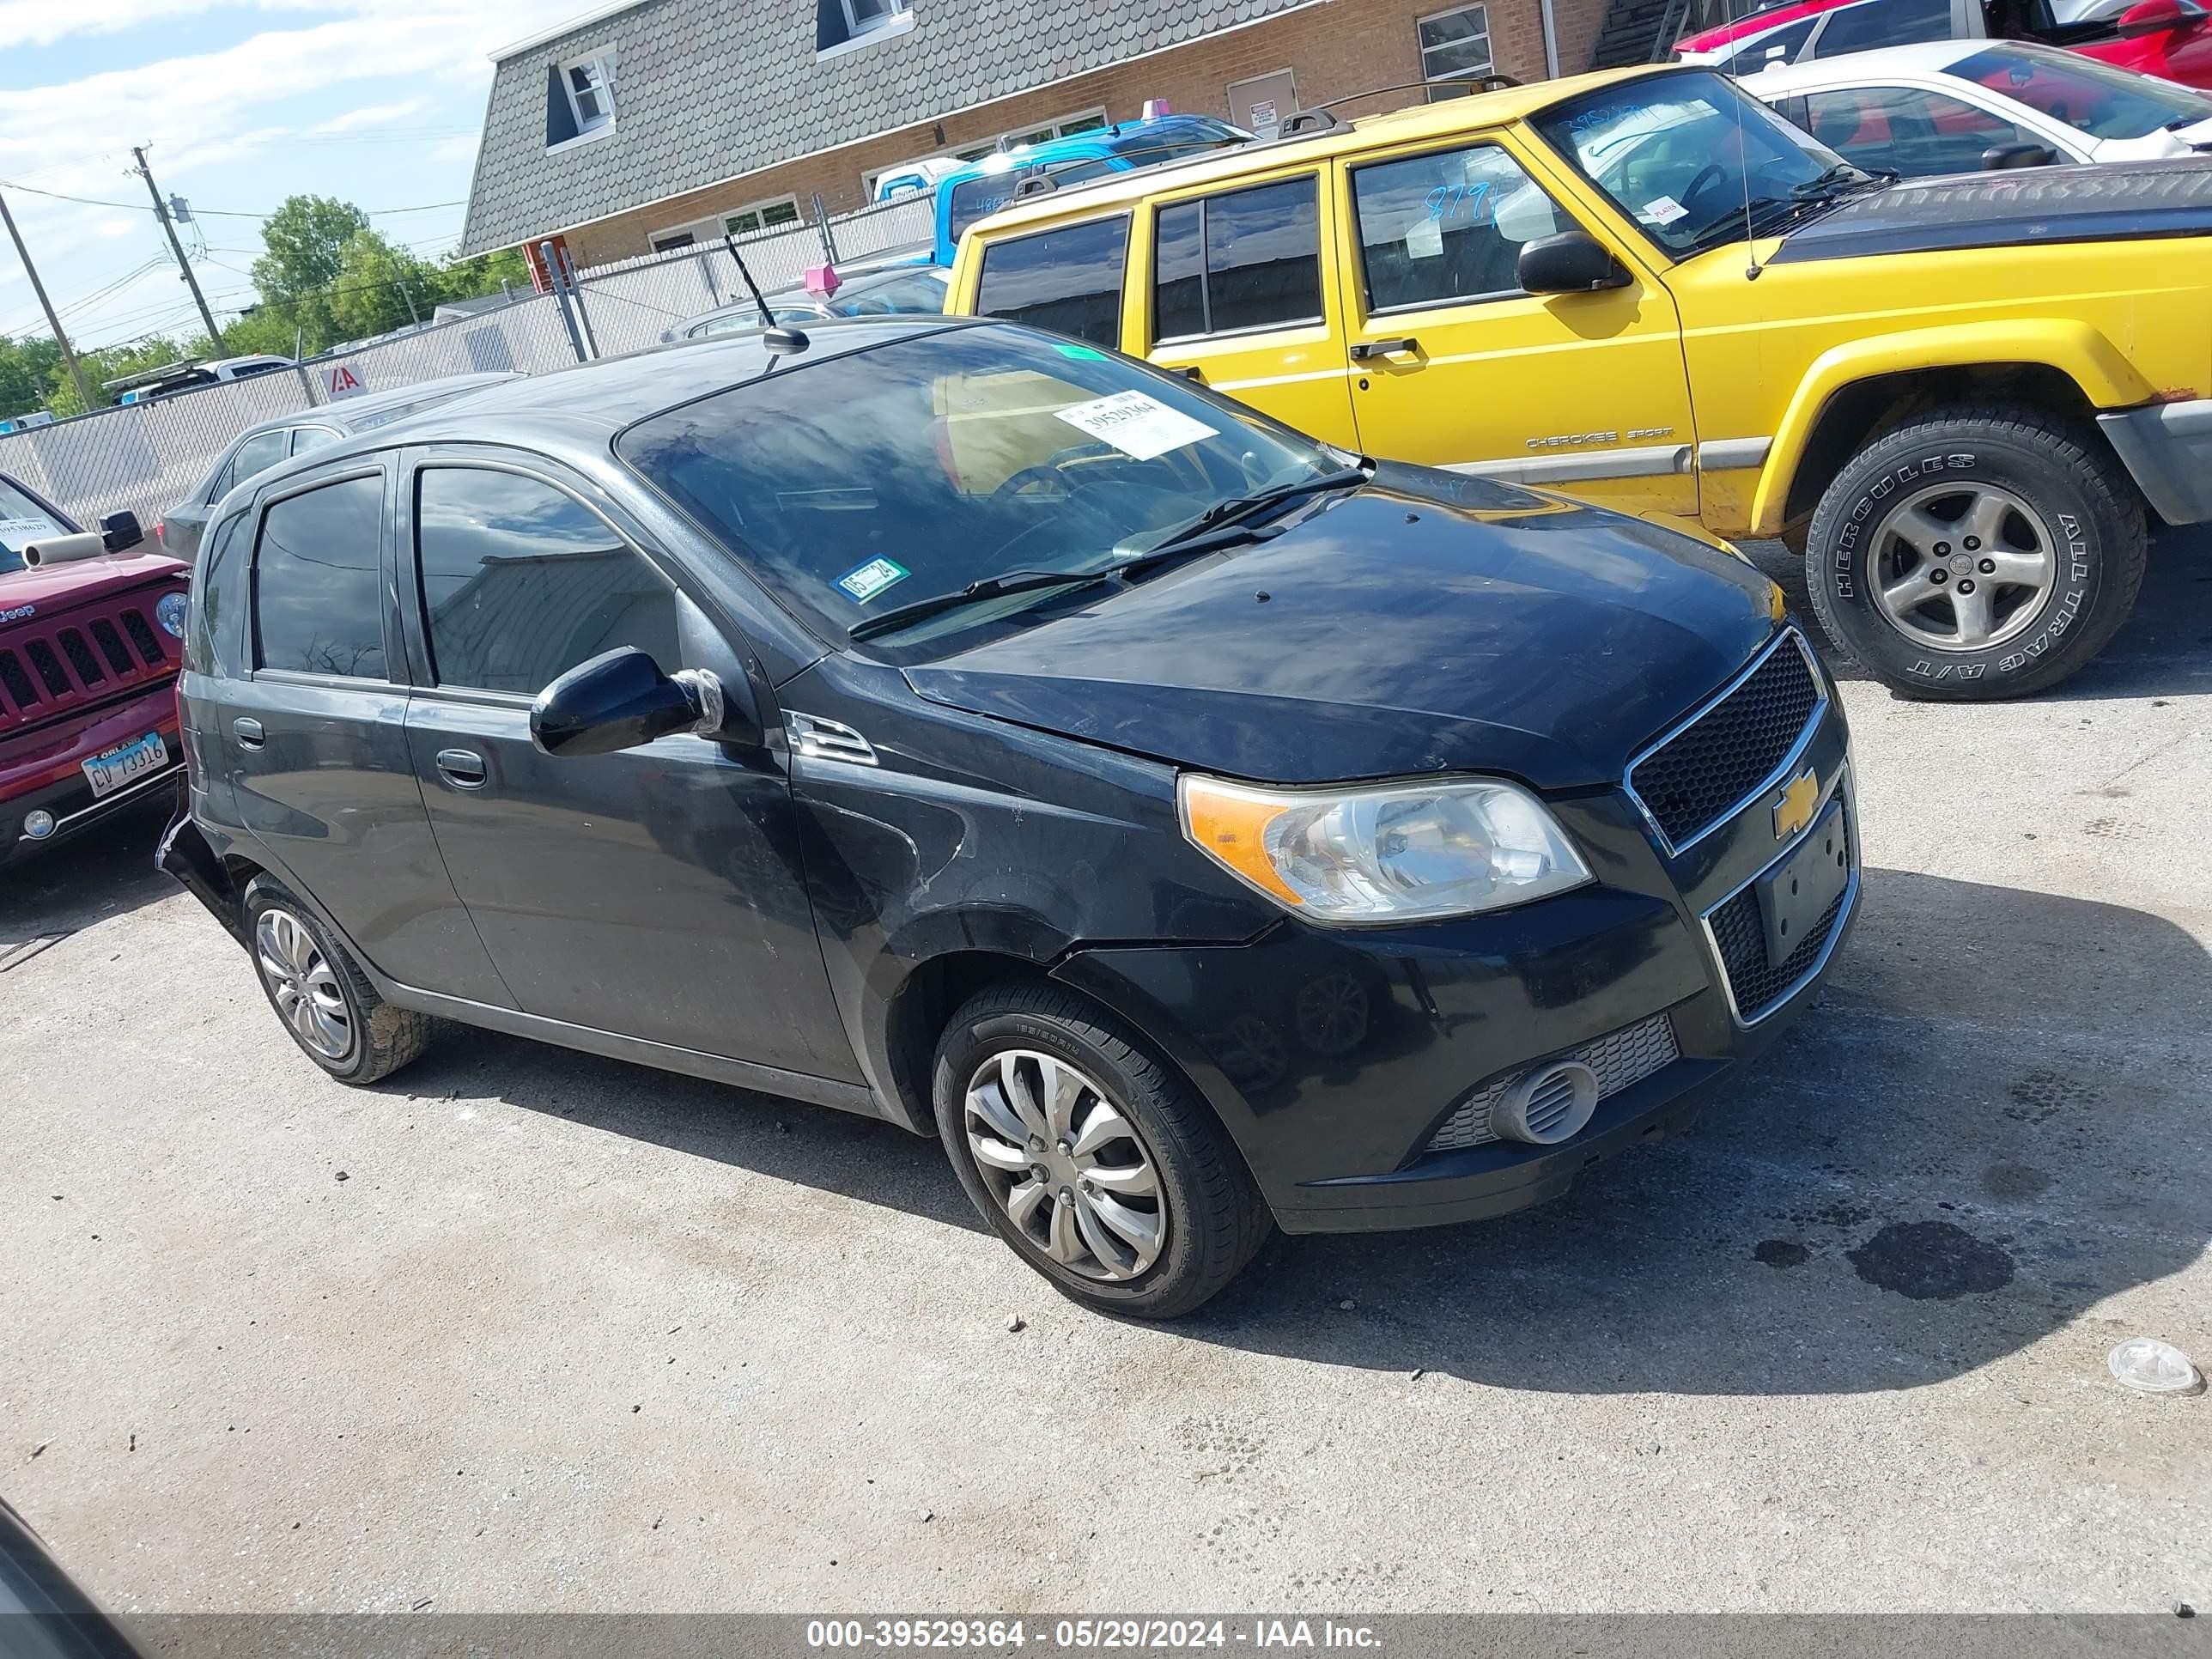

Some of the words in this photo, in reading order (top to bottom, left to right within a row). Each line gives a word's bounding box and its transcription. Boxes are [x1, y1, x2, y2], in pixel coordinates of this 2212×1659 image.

[1654, 204, 1677, 218] PLATES
[1085, 402, 1158, 430] 39529364
[1525, 431, 1618, 448] CHEROKEE
[1627, 427, 1673, 440] SPORT
[1834, 453, 1976, 599] HERCULES
[2057, 513, 2089, 583] ALL
[0, 605, 35, 623] Jeep
[1998, 587, 2086, 673] TRAC
[100, 736, 142, 759] ORLAND
[92, 764, 112, 788] CV
[117, 740, 163, 775] 73316
